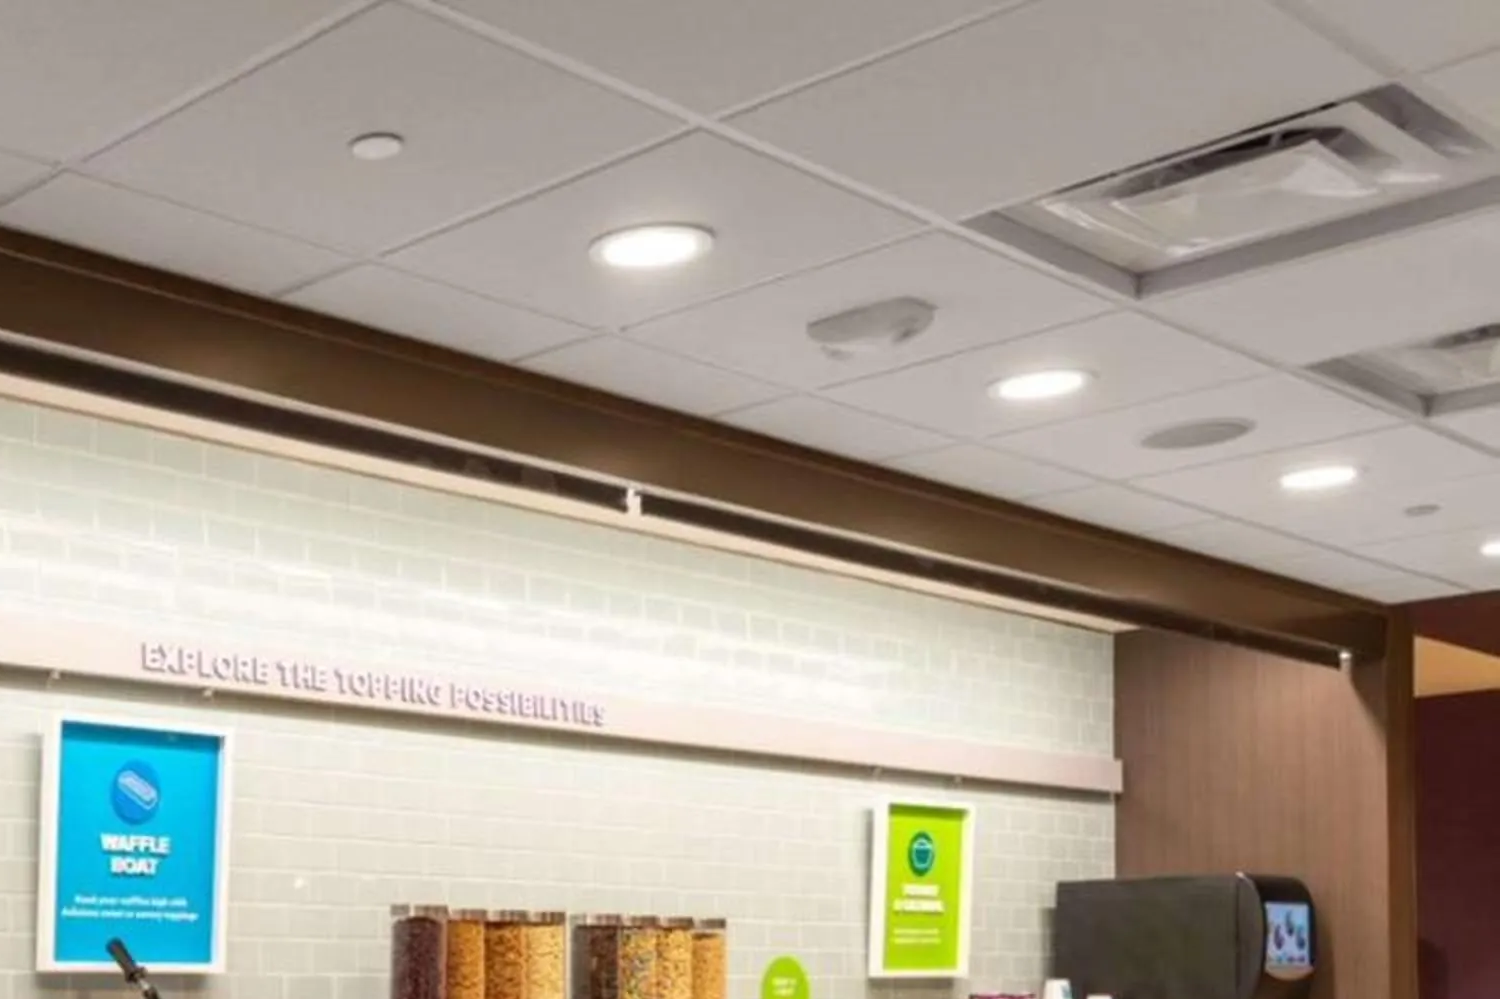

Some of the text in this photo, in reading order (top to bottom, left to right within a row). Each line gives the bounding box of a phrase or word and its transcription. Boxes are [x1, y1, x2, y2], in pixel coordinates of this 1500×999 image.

[141, 642, 606, 727] EXPLORE THE TOPPING POSSIBILITIES
[100, 832, 172, 855] WAFFLE
[110, 855, 158, 877] BOAT
